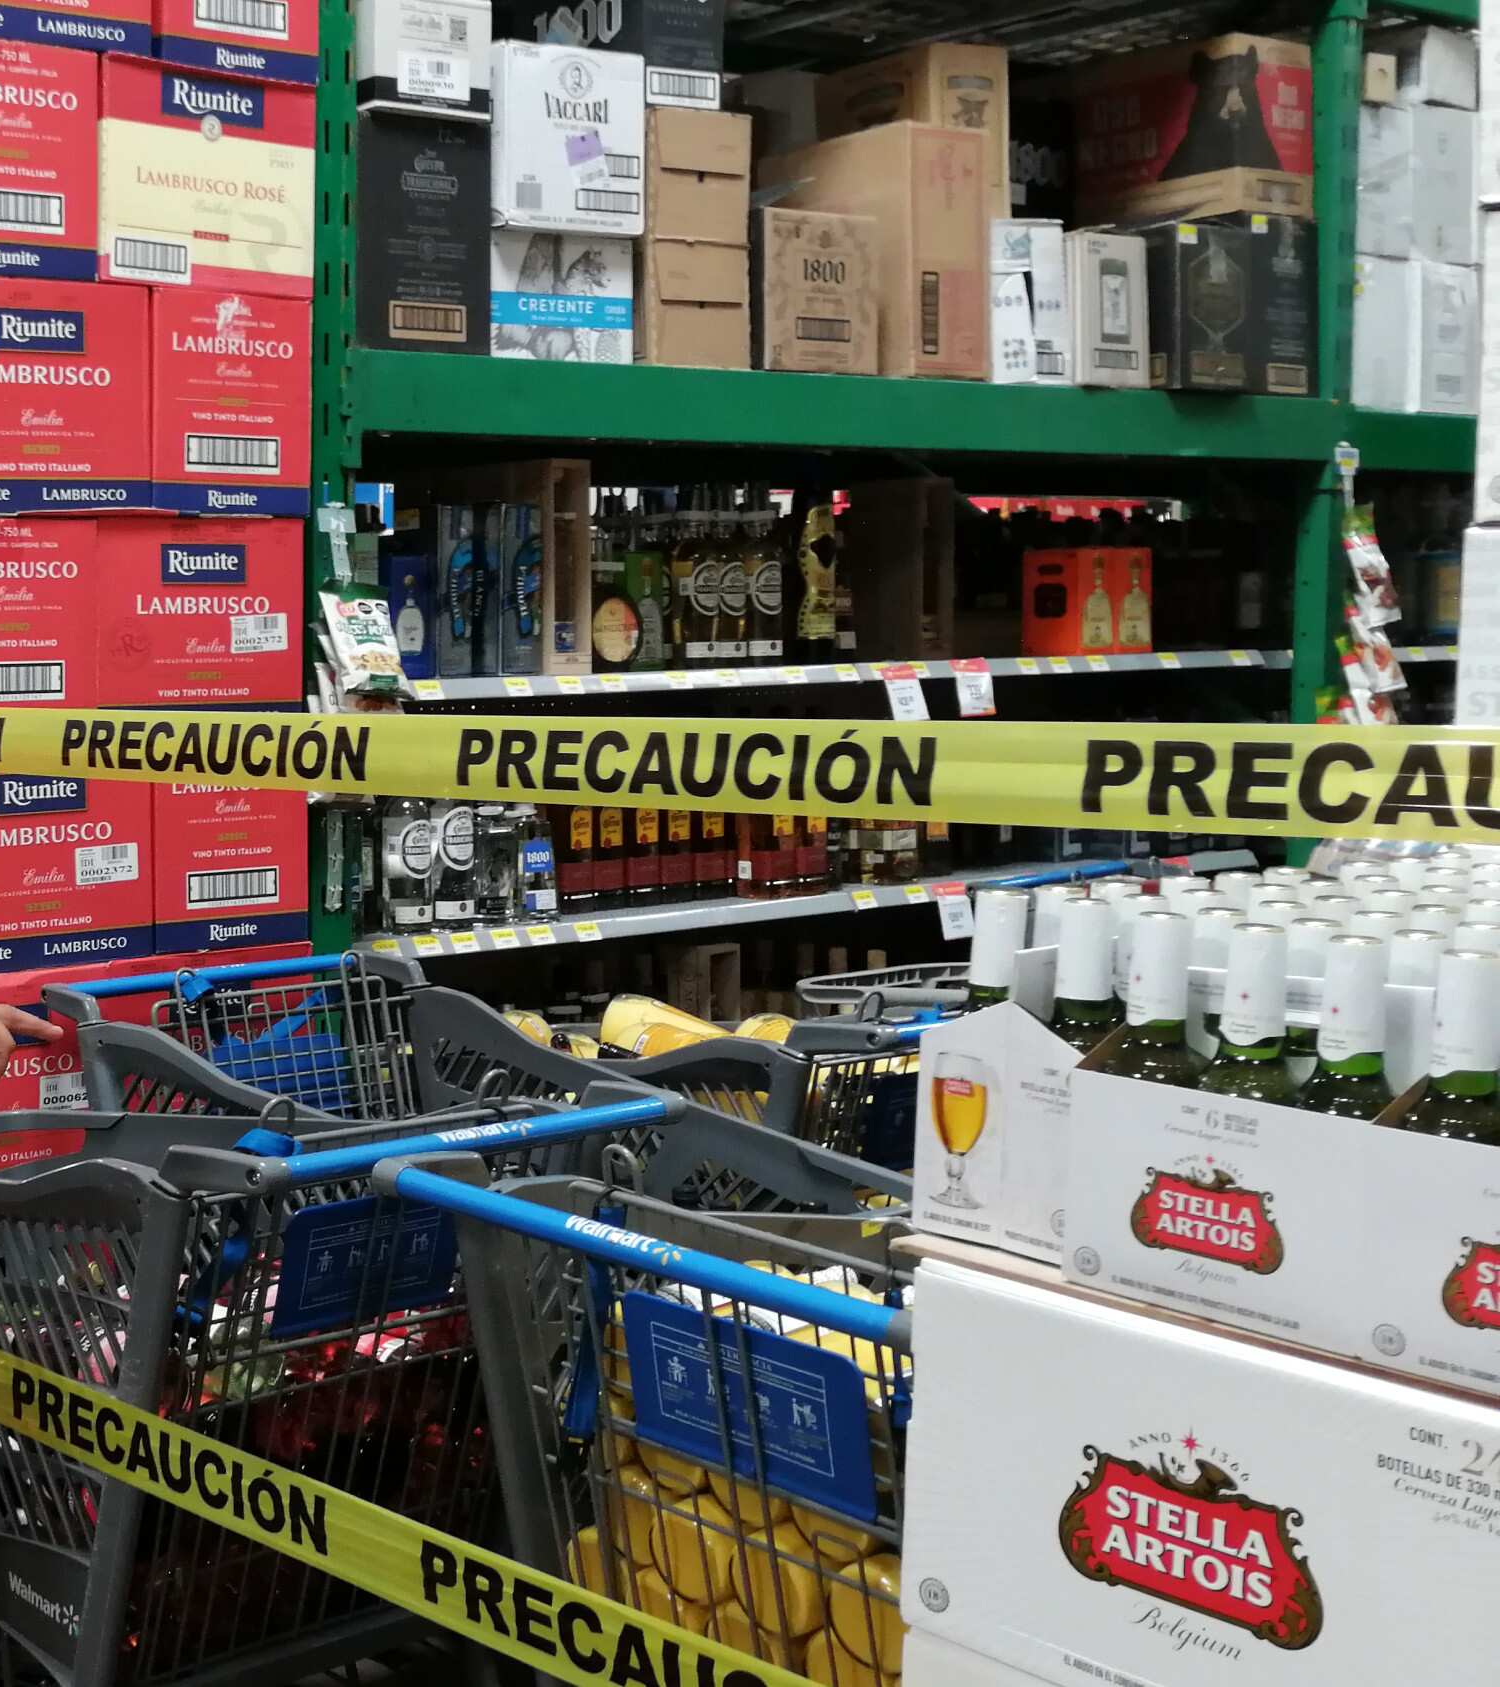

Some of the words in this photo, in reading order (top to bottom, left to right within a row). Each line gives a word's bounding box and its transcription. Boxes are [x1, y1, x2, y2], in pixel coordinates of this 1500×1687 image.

[37, 16, 125, 42] LAMBRUSCO
[216, 47, 266, 70] Riunite
[173, 77, 253, 116] Riunite
[544, 91, 608, 124] VACCARI
[18, 165, 57, 179] ITALIANO
[137, 166, 237, 197] LAMBRUSCO
[244, 181, 286, 204] ROSÉ
[803, 258, 845, 284] 1800
[518, 297, 595, 315] CREYENTE
[0, 313, 77, 343] Riunite
[172, 331, 293, 359] LAMBRUSCO
[20, 408, 65, 427] Emilia
[214, 412, 237, 422] TINTO
[238, 413, 273, 424] ITALIANO
[18, 463, 46, 472] TINTO
[48, 463, 92, 473] ITALIANO
[42, 487, 127, 501] LAMBRUSCO
[207, 490, 257, 509] Riunite
[168, 550, 239, 576] Riunite
[137, 594, 270, 615] LAMBRUSCO
[19, 639, 58, 648] ITALIANO
[186, 637, 226, 655] Emilia
[234, 635, 282, 646] 0002372
[210, 688, 249, 696] ITALIANO
[62, 719, 370, 781] PRECAUCIÓN
[457, 729, 936, 806] PRECAUCIÓN
[3, 780, 77, 806] Riunite
[215, 798, 251, 814] Emilia
[193, 850, 211, 858] VINO
[237, 846, 272, 855] ITALIANO
[527, 851, 549, 863] 1800
[23, 867, 66, 886] Emilia
[81, 865, 132, 877] 0002372
[20, 919, 48, 929] TINTO
[50, 915, 92, 927] ITALIANO
[210, 924, 257, 941] Riunite
[44, 937, 127, 956] LAMBRUSCO
[1, 1053, 74, 1078] RUSCO
[1205, 1109, 1219, 1130] 6
[438, 1122, 509, 1145] Walmart
[11, 1148, 52, 1161] ITALIANO
[1158, 1190, 1256, 1228] STELLA
[566, 1213, 654, 1253] Walmart
[1156, 1213, 1256, 1252] ARTOIS
[1129, 1432, 1171, 1449] ANNO
[1410, 1426, 1448, 1449] CONT.
[1377, 1453, 1441, 1484] BOTELLAS
[1446, 1473, 1462, 1489] DE
[1467, 1479, 1490, 1497] 330
[1394, 1478, 1457, 1506] Cerveza
[12, 1368, 328, 1556] PRECAUCIÓN
[420, 1539, 770, 1687] PRECAU
[1105, 1485, 1273, 1568] STELLA
[1102, 1525, 1273, 1609] ARTOIS
[8, 1570, 61, 1623] Walmart
[1133, 1603, 1244, 1662] Belgium
